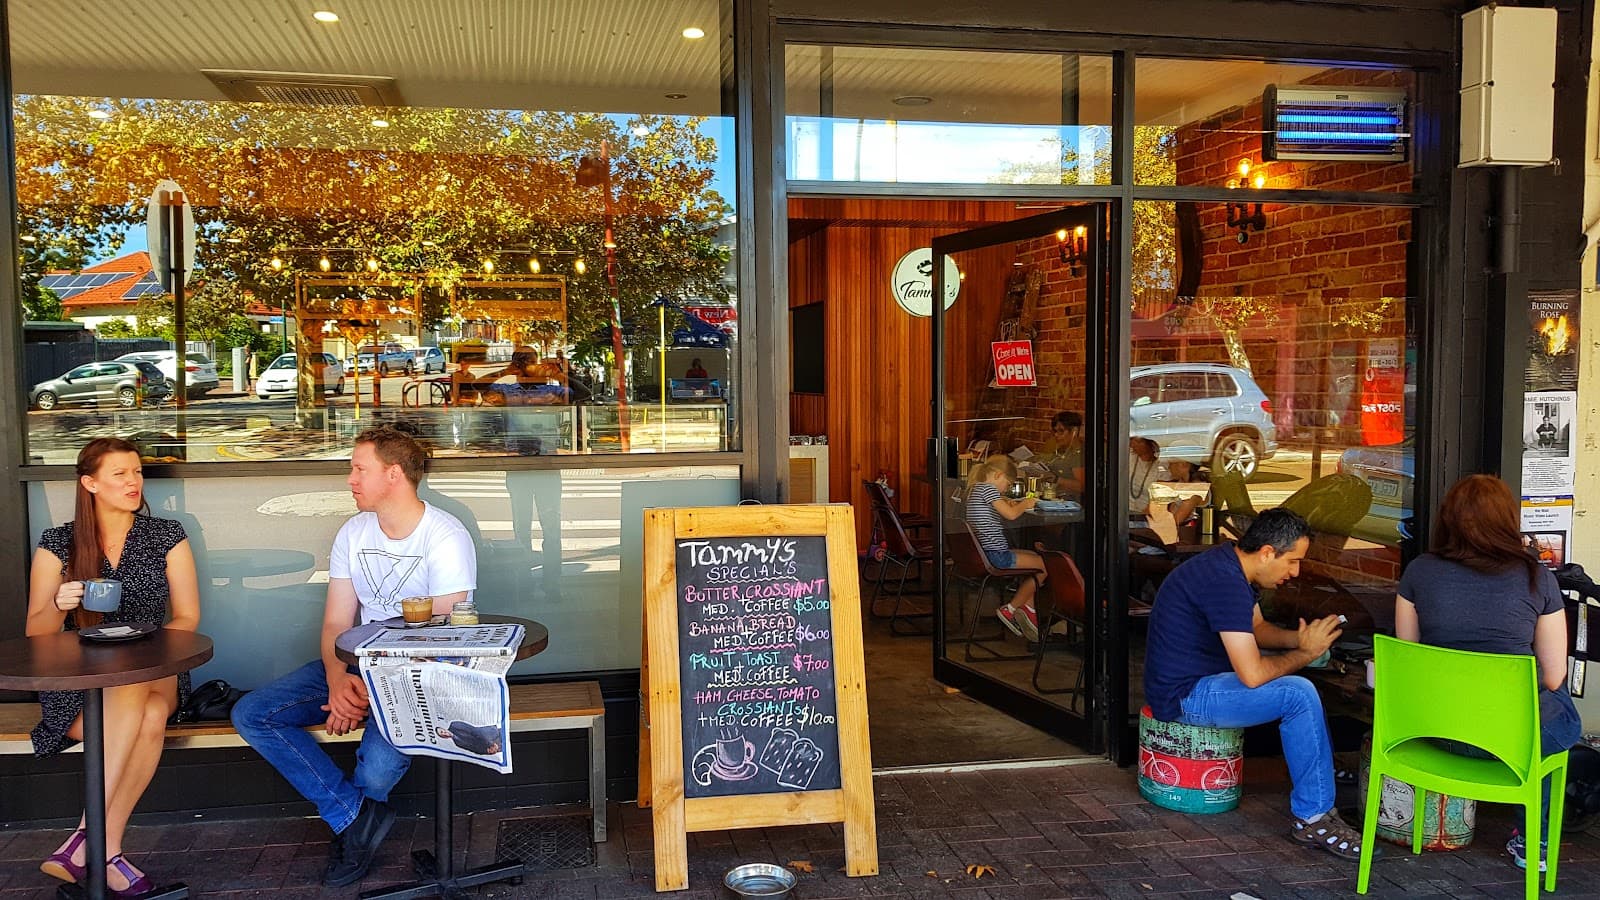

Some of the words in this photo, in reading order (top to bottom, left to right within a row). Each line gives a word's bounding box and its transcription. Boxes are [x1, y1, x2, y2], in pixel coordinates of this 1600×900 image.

[998, 364, 1032, 380] OPEN
[685, 585, 741, 603] BUTTER
[745, 578, 826, 599] CROSSIANT
[744, 597, 791, 613] COFFEE
[793, 595, 830, 616] $5.00
[688, 618, 744, 637] BANANA
[750, 616, 796, 632] BREAD
[749, 630, 795, 646] COFFEE
[795, 622, 830, 644] $6.00
[689, 651, 737, 671] FRUIT
[743, 651, 781, 666] TOAST
[792, 653, 830, 672] $7.00
[748, 665, 791, 682] COFFEE
[777, 685, 821, 701] TOMATO
[411, 669, 437, 745] commitment
[413, 718, 426, 742] Our
[740, 713, 794, 728] COFFEE
